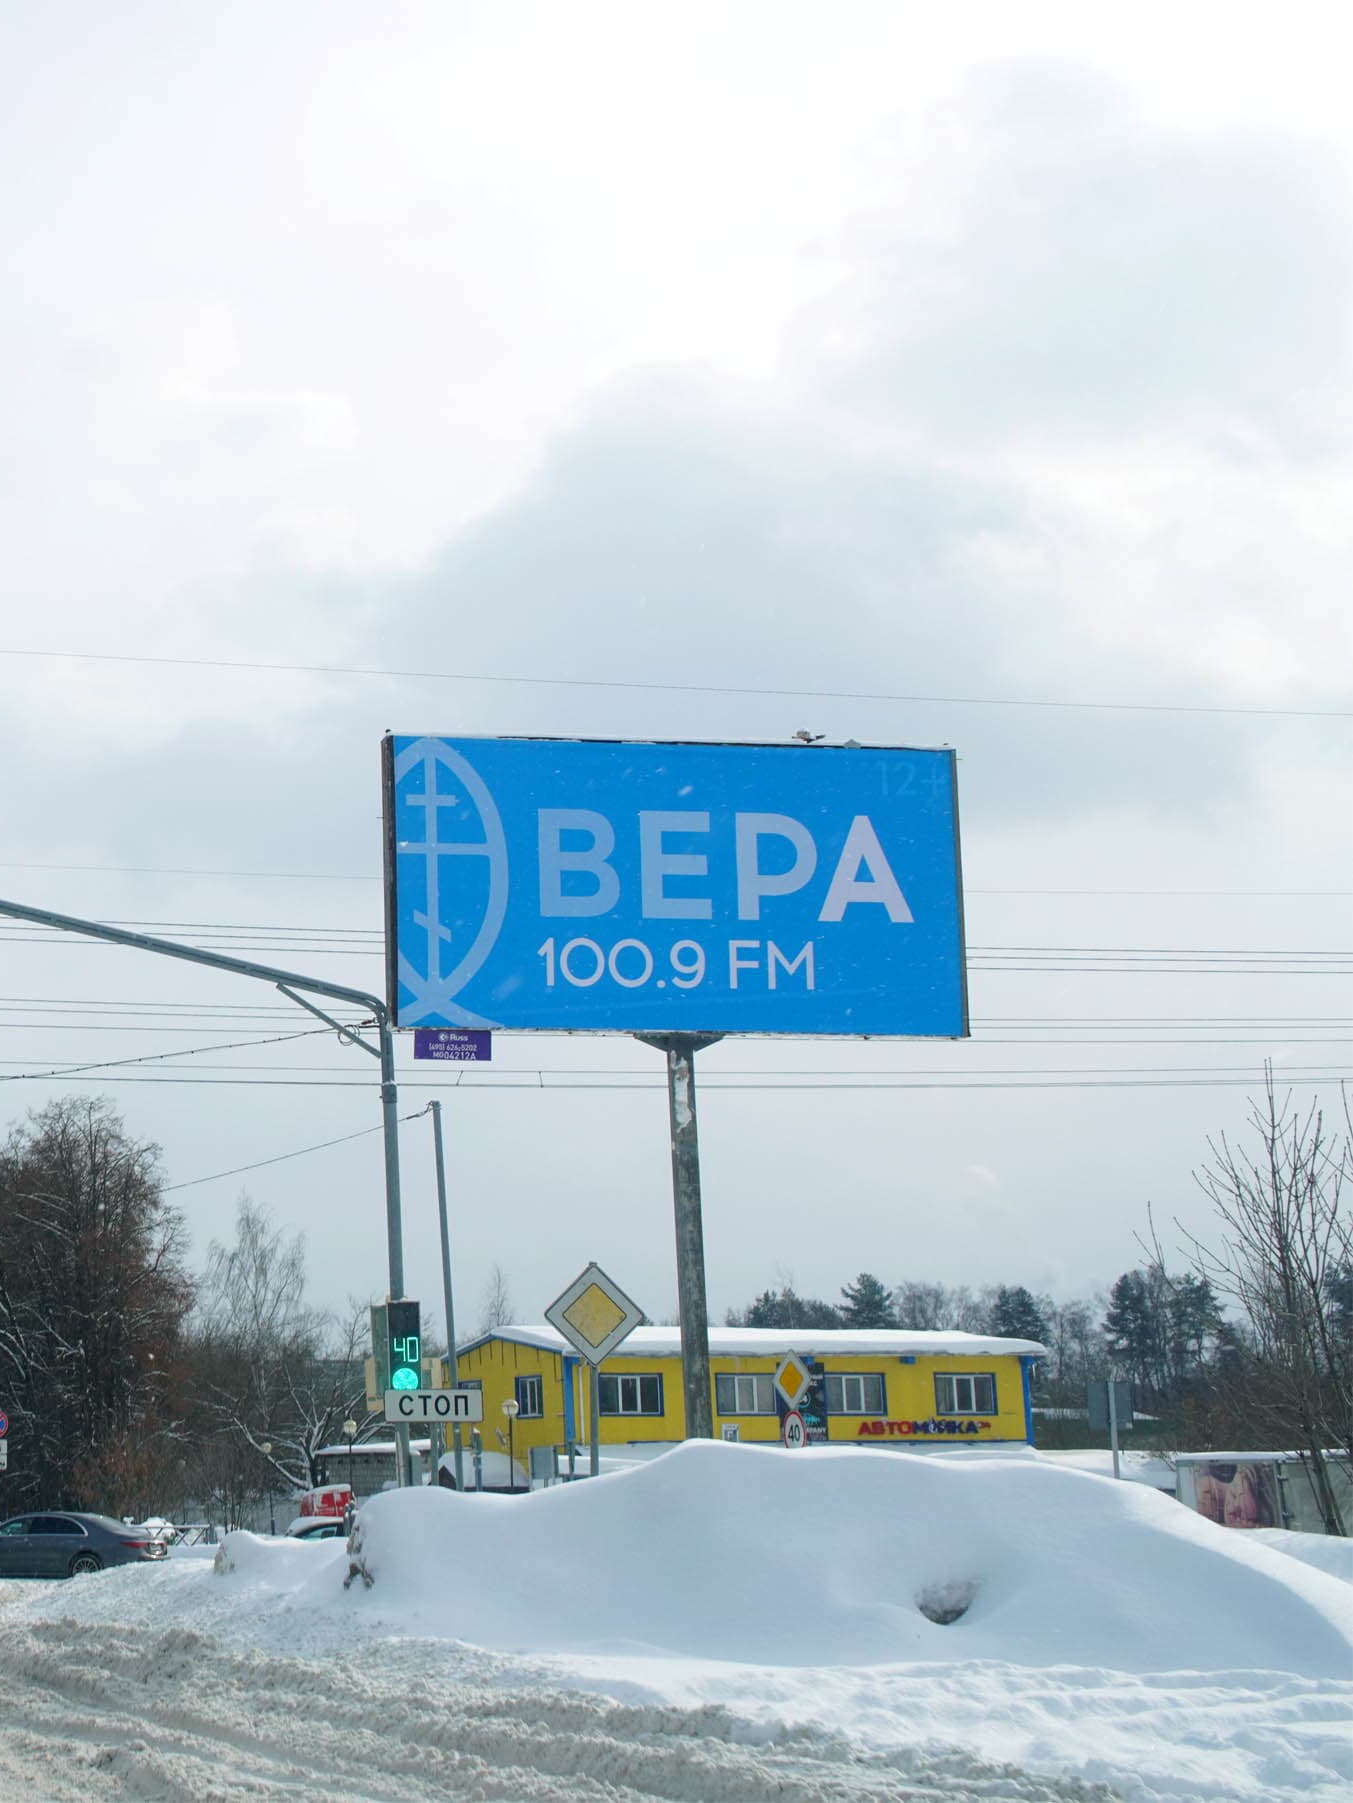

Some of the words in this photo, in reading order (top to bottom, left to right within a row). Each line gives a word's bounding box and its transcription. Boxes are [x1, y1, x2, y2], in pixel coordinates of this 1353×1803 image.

[873, 760, 948, 796] 12+
[538, 808, 915, 923] ВЕРА
[537, 937, 706, 989] 100.9
[728, 939, 815, 990] FM
[393, 1337, 419, 1362] 40
[399, 1395, 468, 1416] СТОП
[787, 1424, 801, 1442] 40
